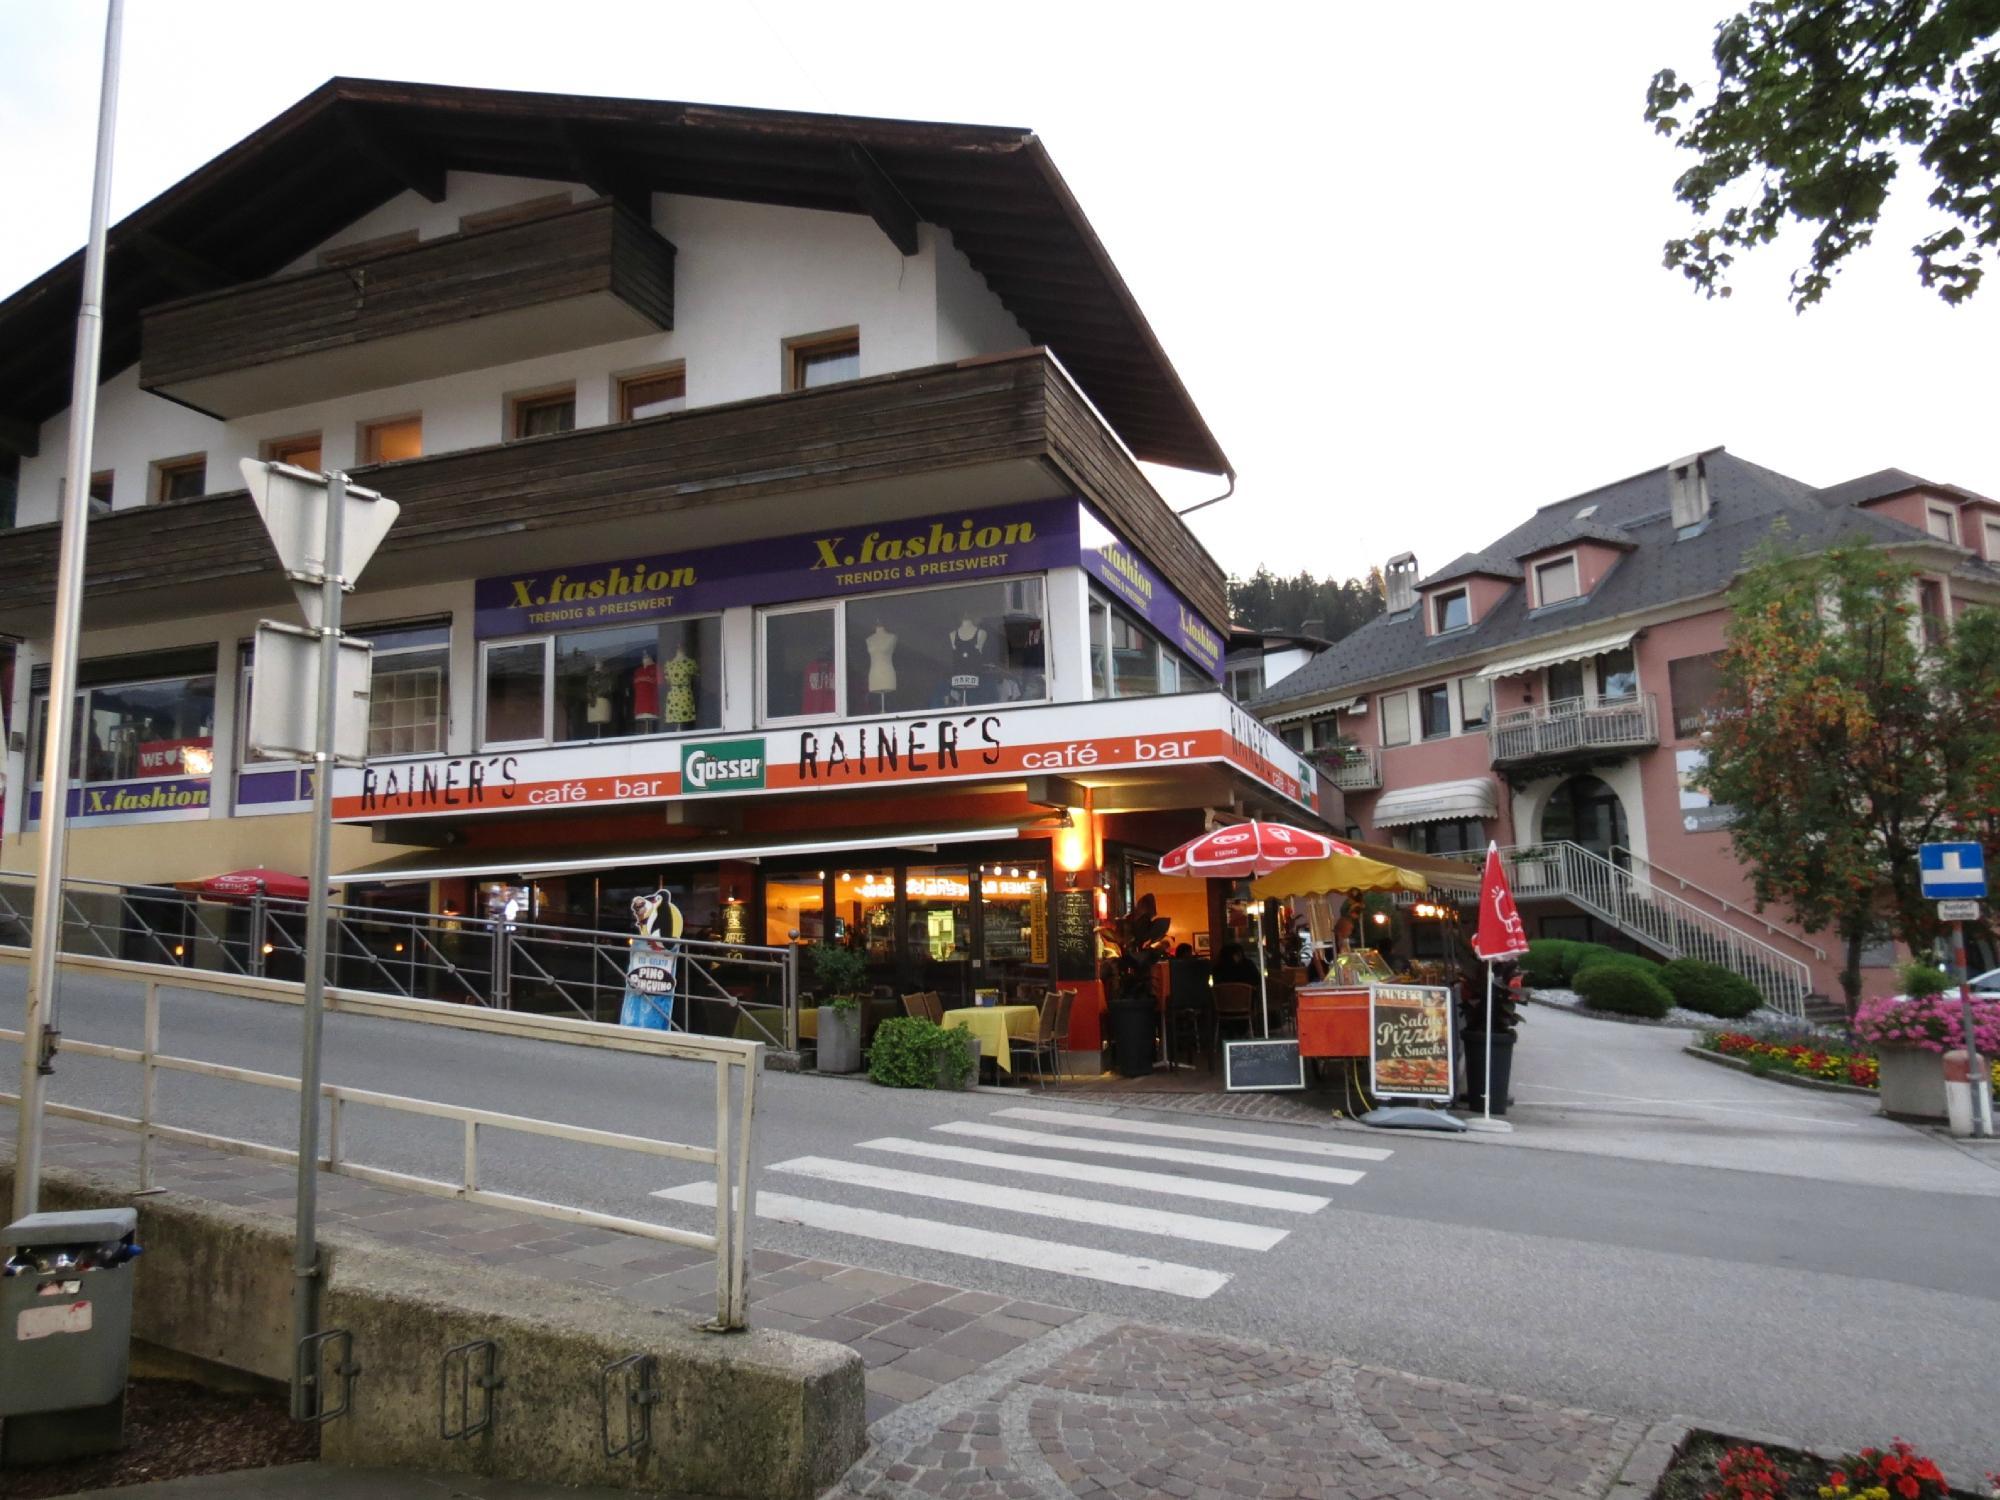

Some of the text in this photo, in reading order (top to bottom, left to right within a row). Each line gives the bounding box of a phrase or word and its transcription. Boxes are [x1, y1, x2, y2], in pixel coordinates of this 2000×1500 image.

[809, 519, 1036, 570] X.fashion
[835, 554, 1008, 586] TRENDIG & PREISWERT
[506, 564, 697, 609] X.fashion
[528, 596, 674, 624] TRENDIG & PREISWERT
[1022, 737, 1197, 770] café bar
[686, 750, 762, 788] Gösser
[88, 785, 209, 813] X.fashion
[528, 777, 662, 804] café bar
[639, 967, 664, 980] PINO
[1376, 1022, 1441, 1046] Pizza
[1391, 1042, 1447, 1057] & Snacks
